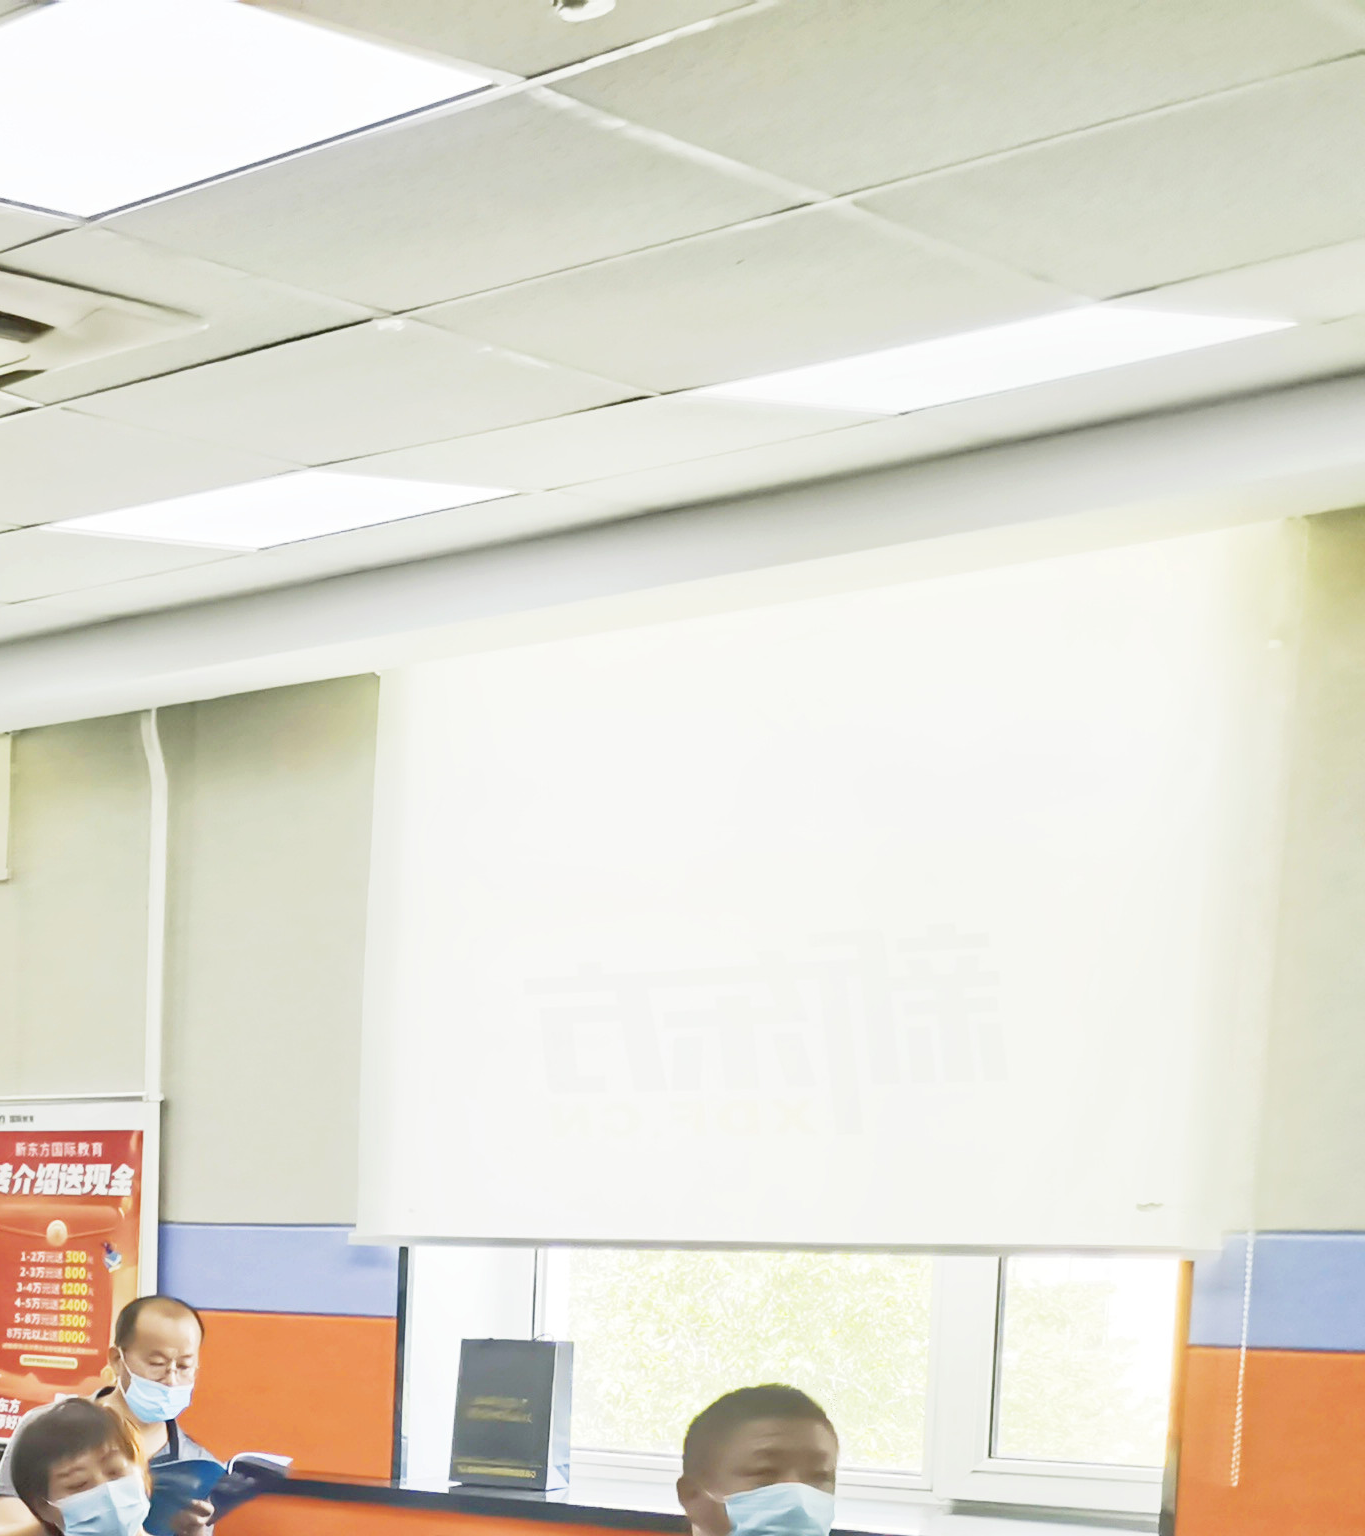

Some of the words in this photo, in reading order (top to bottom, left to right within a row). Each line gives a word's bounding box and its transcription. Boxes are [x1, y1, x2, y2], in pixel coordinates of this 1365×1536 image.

[15, 1141, 103, 1157] 新东方国际教育
